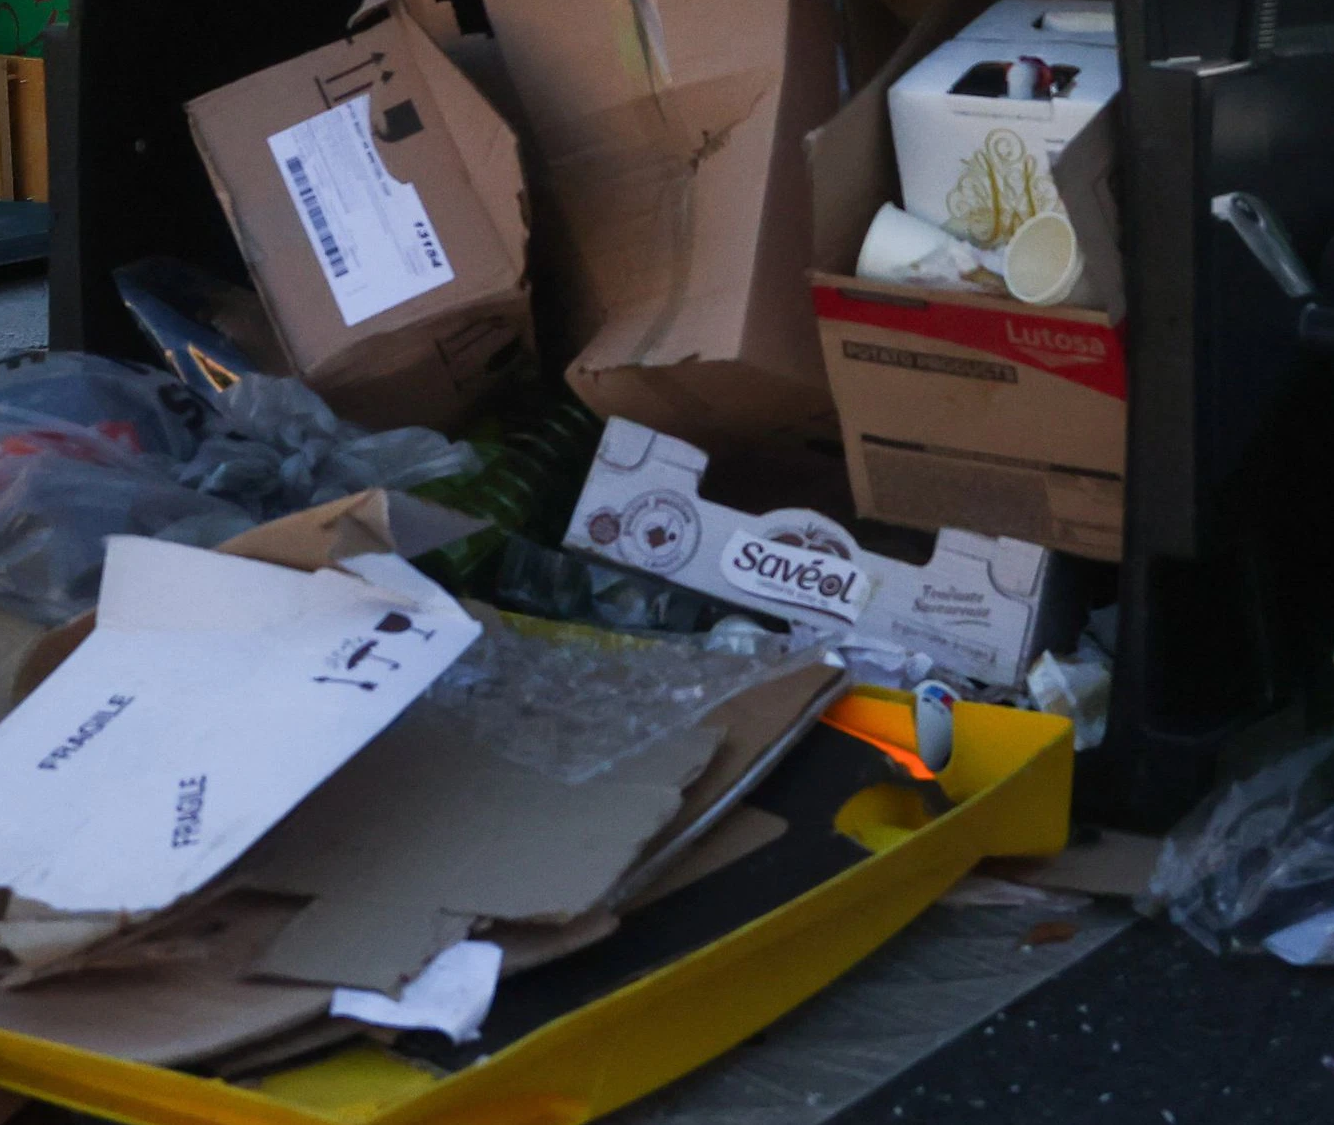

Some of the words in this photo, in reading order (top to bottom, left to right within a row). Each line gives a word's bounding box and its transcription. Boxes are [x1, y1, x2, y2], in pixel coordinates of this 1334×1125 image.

[1005, 318, 1107, 357] Lutosa
[733, 540, 858, 605] Savéol
[36, 693, 135, 770] FRAGILE
[169, 774, 207, 849] FRAGILE
